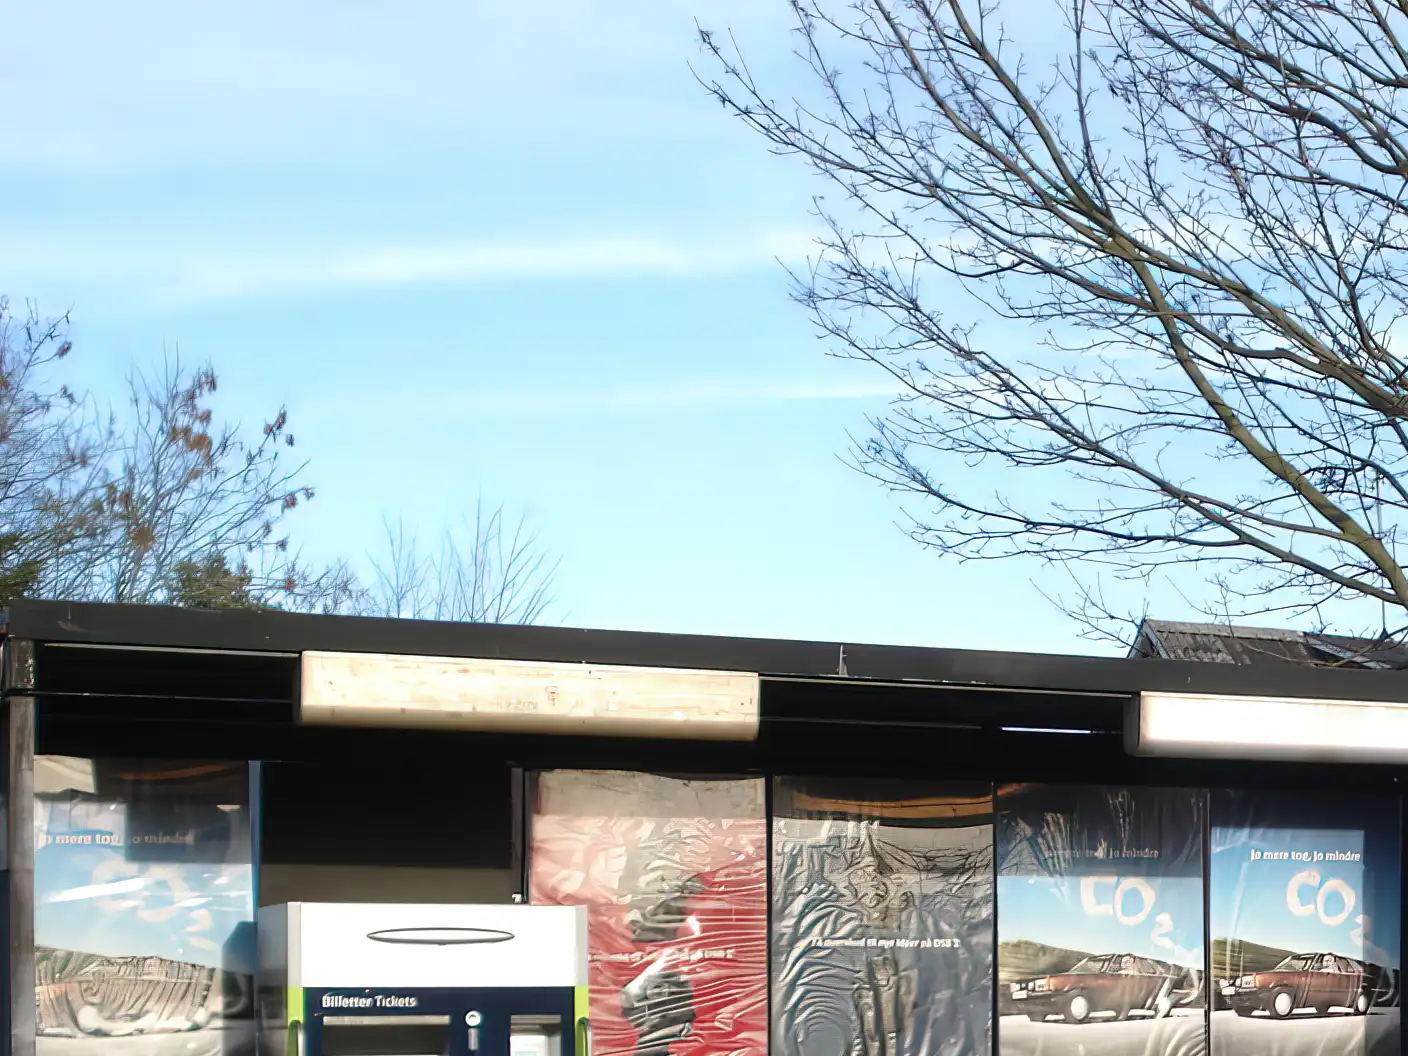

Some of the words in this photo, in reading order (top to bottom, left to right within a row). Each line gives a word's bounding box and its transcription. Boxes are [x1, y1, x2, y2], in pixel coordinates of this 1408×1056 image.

[1325, 850, 1361, 861] mindre
[322, 995, 373, 1008] Billetter
[374, 994, 418, 1007] Tickets
